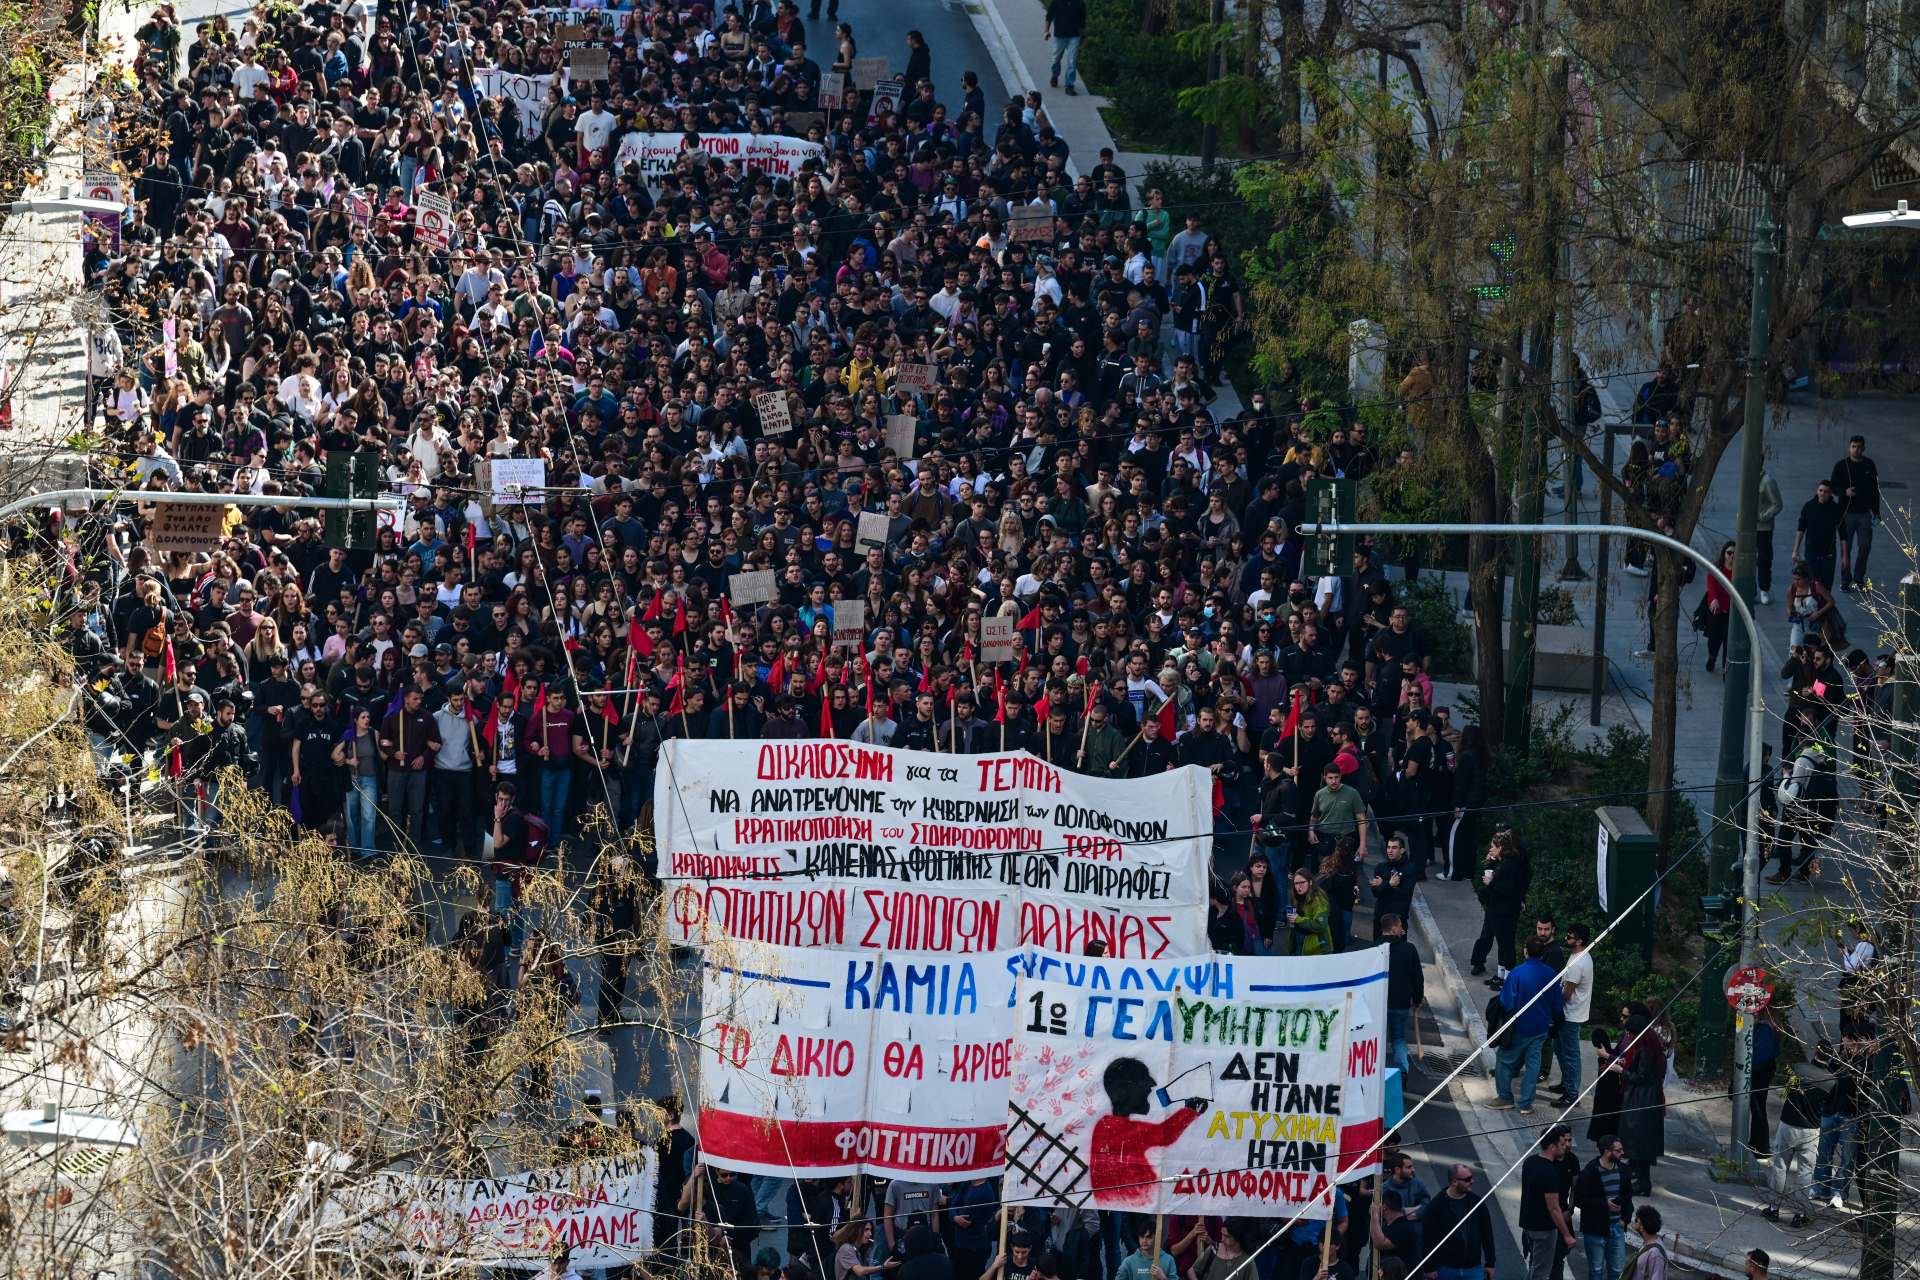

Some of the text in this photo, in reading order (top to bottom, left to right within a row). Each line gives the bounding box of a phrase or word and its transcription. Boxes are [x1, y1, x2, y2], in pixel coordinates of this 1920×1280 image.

[564, 41, 586, 49] ΠΑΡΕ
[763, 419, 789, 430] ΚΡΑΤΙΑ
[757, 743, 1062, 794] ΔΙΚΑΙΟΣΥΝΗ για τα ΤΕΜΠΗ
[709, 786, 1168, 841] ΝΑ ΑΝΑΤΡΕΨΟΥΜΕ την ΚΥΒΕΡΝΗΣΗ των ΔΟΛΟΦΟΝΩΝ
[735, 815, 1123, 862] ΚΡΑΤΙΚΟΠΟΙΗΣΗ του ΣΙΔΗΡΟΔΡΟΜΟΥ ΤΩΡΑ
[671, 852, 785, 882] ΚΑΤΑΛΗΨΕΙΣ
[805, 843, 899, 880] ΚΑΝΕΝΑΣ
[908, 846, 993, 881] ΦΟΙΤΗΤΗΣ
[1063, 861, 1172, 900] ΔΙΑΓΡΑΦΕΙ
[859, 888, 1001, 954] ΣΥΛΛΟΓΩΝ
[845, 960, 977, 1016] ΚΑΜΙΑ
[1085, 995, 1174, 1042] ΓΕΛ
[1176, 997, 1340, 1051] ΥΜΗΤΤΟΥ
[715, 1022, 751, 1070] ΤΟ
[769, 1033, 855, 1078] ΔΙΚΙΟ
[883, 1040, 923, 1081] ΘΑ
[1219, 1052, 1300, 1083] ΔΕΝ
[1250, 1082, 1342, 1115] ΗΤΑΝΕ
[834, 1127, 976, 1168] ΦΟΙΤΗΤΙΚΟΙ
[1207, 1110, 1338, 1144] ΑΤΥΧΗΜΑ
[1247, 1139, 1327, 1172] ΗΤΑΝ
[1172, 1167, 1332, 1207] ΔΟΛΟΦΟΝΙΑ
